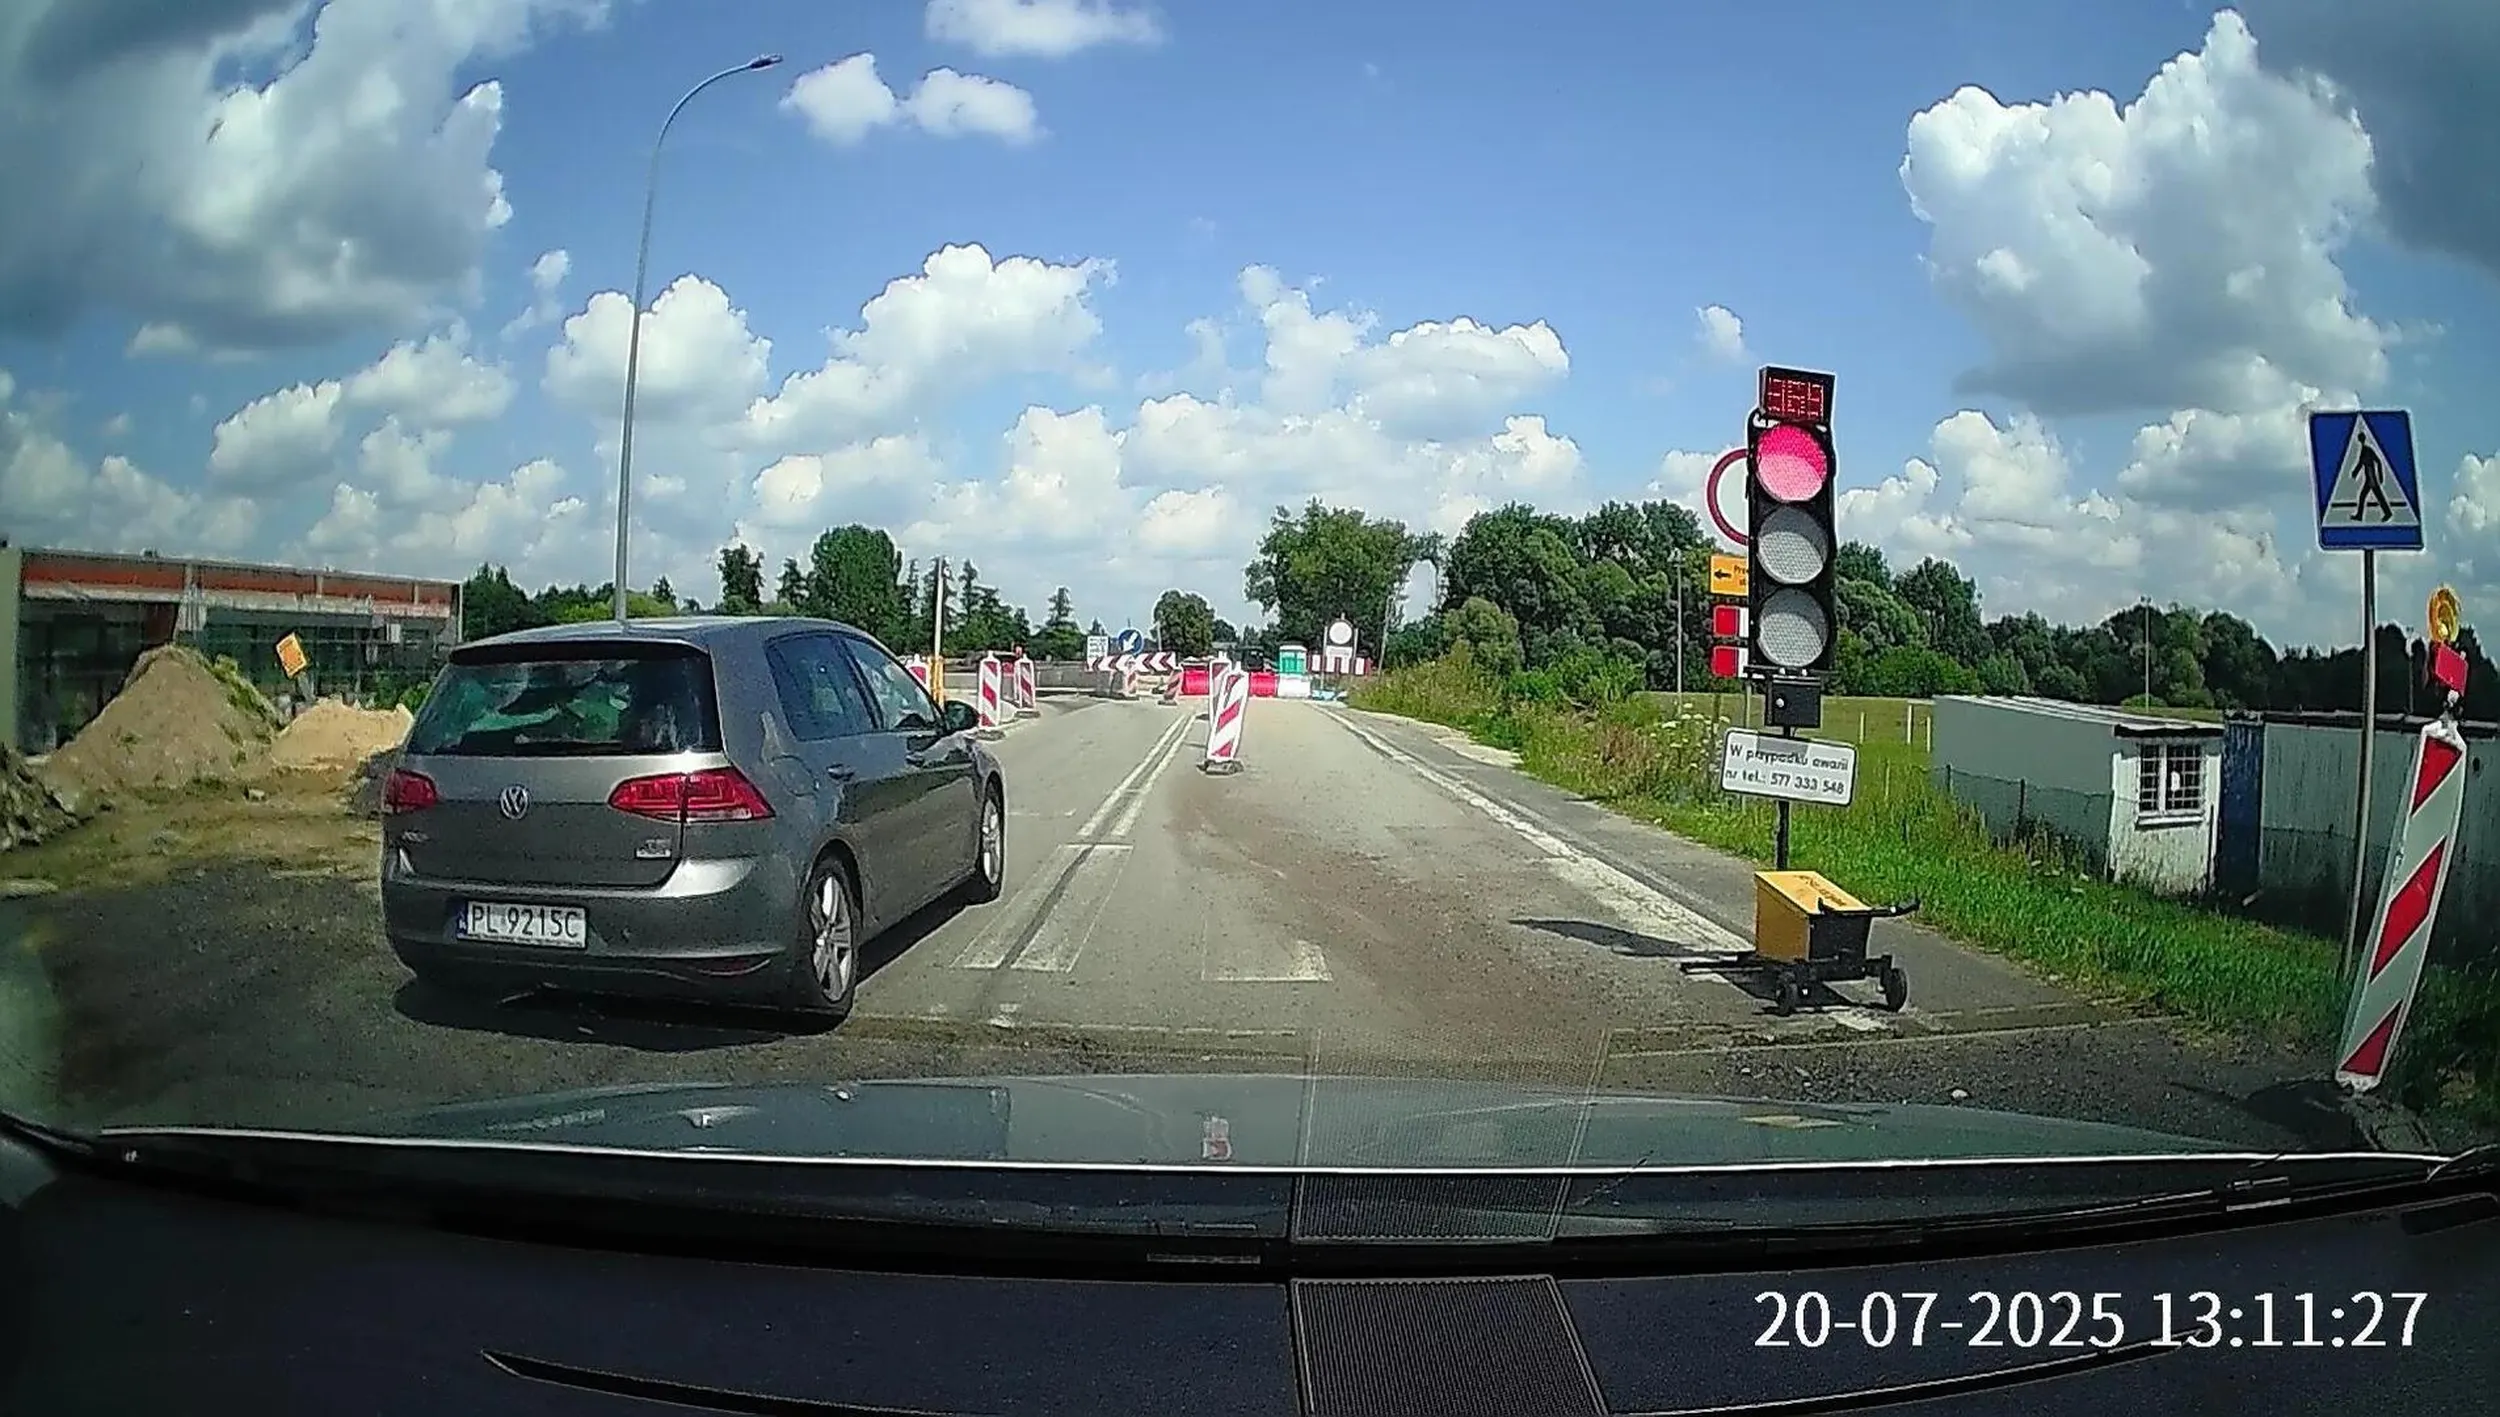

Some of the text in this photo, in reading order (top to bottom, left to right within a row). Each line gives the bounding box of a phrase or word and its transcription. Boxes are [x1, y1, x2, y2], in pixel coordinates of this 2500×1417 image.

[1730, 744, 1743, 756] W
[1770, 773, 1791, 787] 577
[1794, 776, 1818, 790] 333
[472, 904, 498, 933] PL
